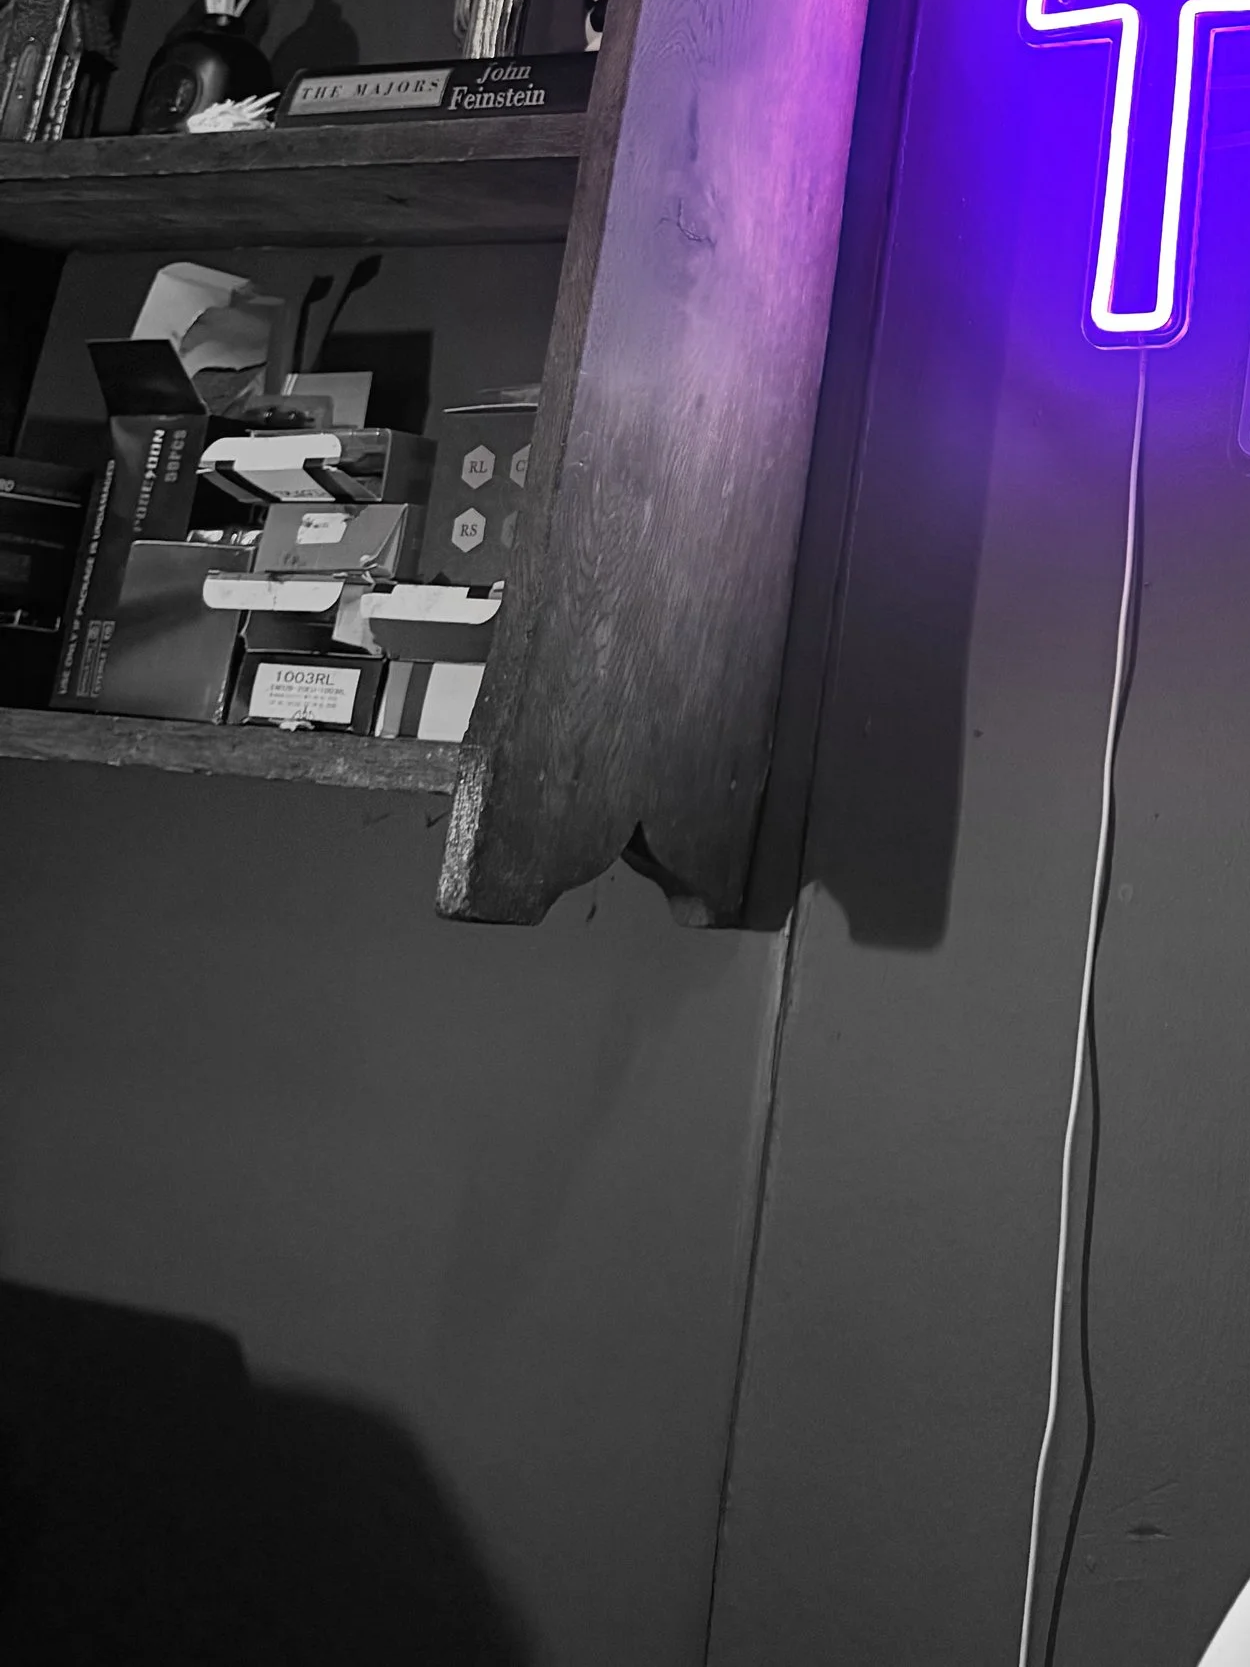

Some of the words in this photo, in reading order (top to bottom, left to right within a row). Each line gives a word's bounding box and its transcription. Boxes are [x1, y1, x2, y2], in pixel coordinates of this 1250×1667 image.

[476, 61, 532, 84] John
[303, 85, 343, 100] THE
[354, 78, 440, 96] MAJORS
[447, 83, 546, 111] Feinstein
[468, 461, 488, 473] RL
[460, 524, 478, 537] RS
[276, 670, 336, 686] 1003RL
